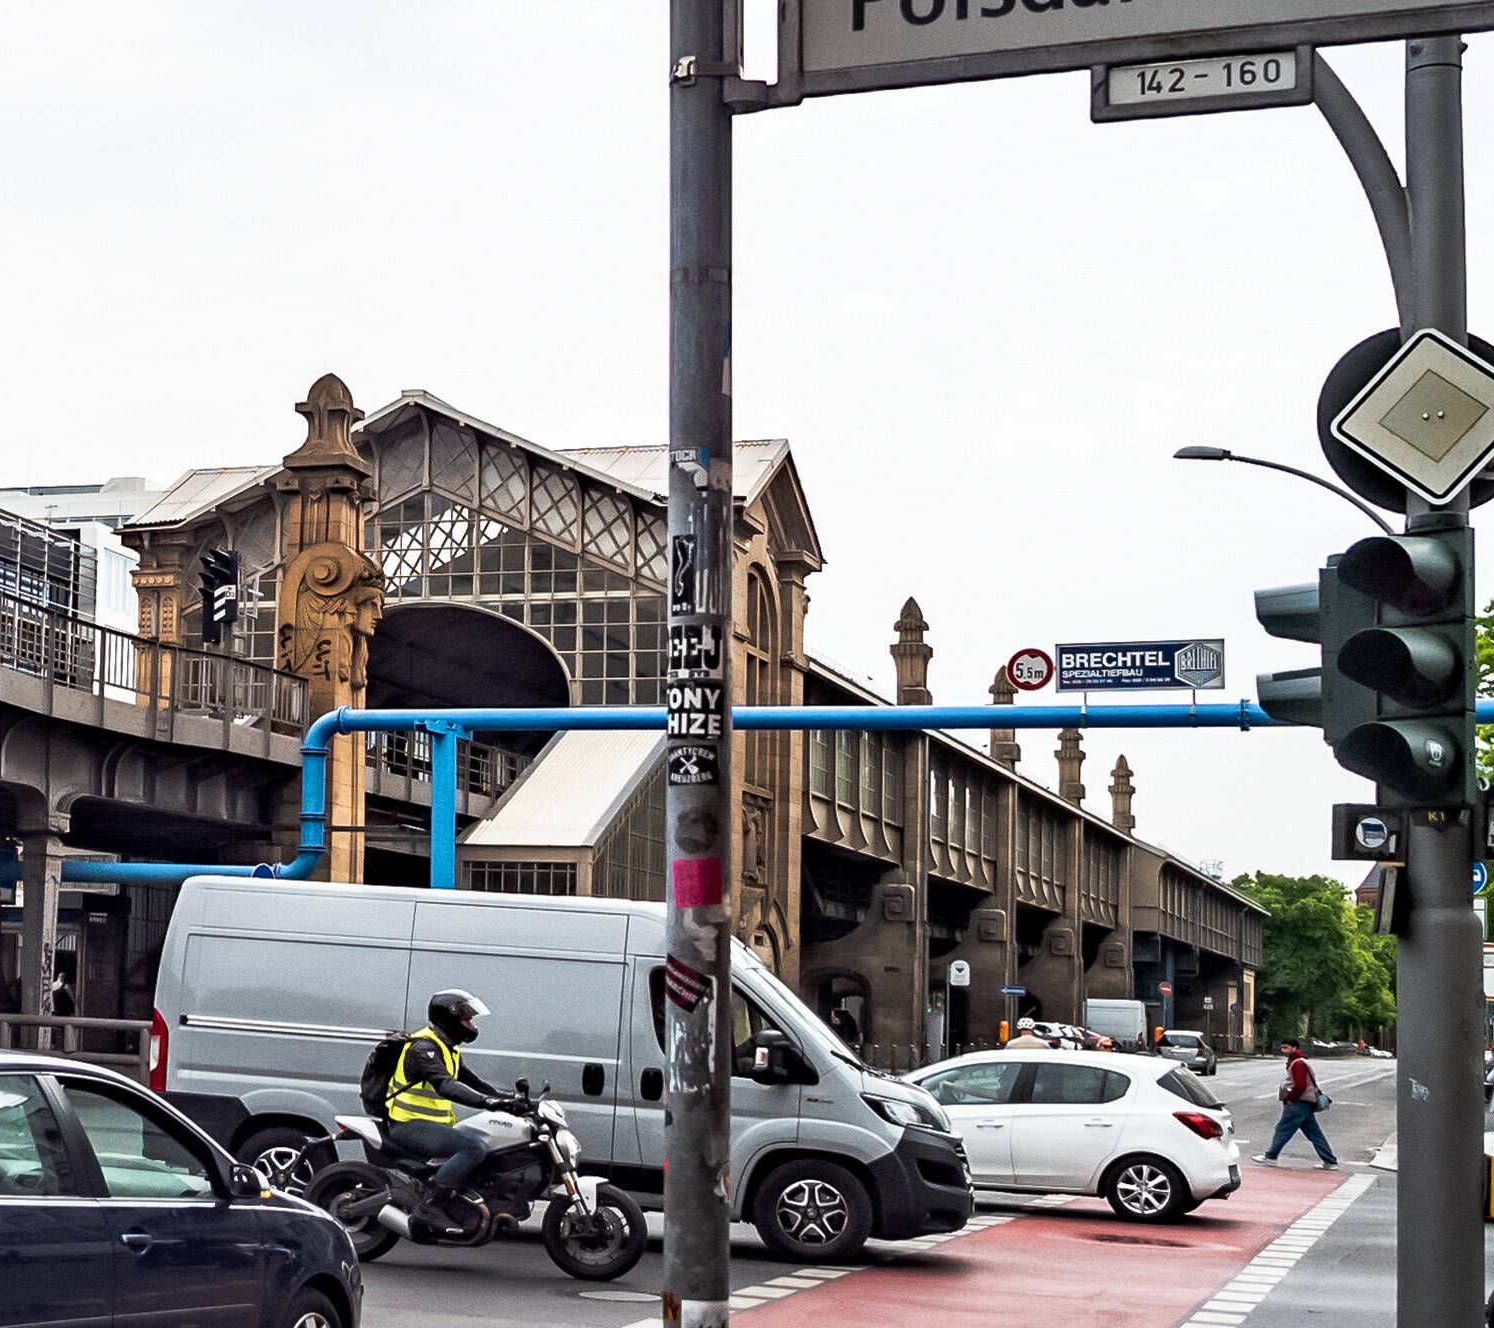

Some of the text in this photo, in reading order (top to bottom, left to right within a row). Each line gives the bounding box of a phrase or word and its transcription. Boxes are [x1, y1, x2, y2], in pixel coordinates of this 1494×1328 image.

[1062, 651, 1170, 668] BRECHTEL
[1062, 669, 1144, 679] SPEZIALTIEFBAU
[667, 687, 721, 709] ONY
[667, 713, 722, 735] HIZE
